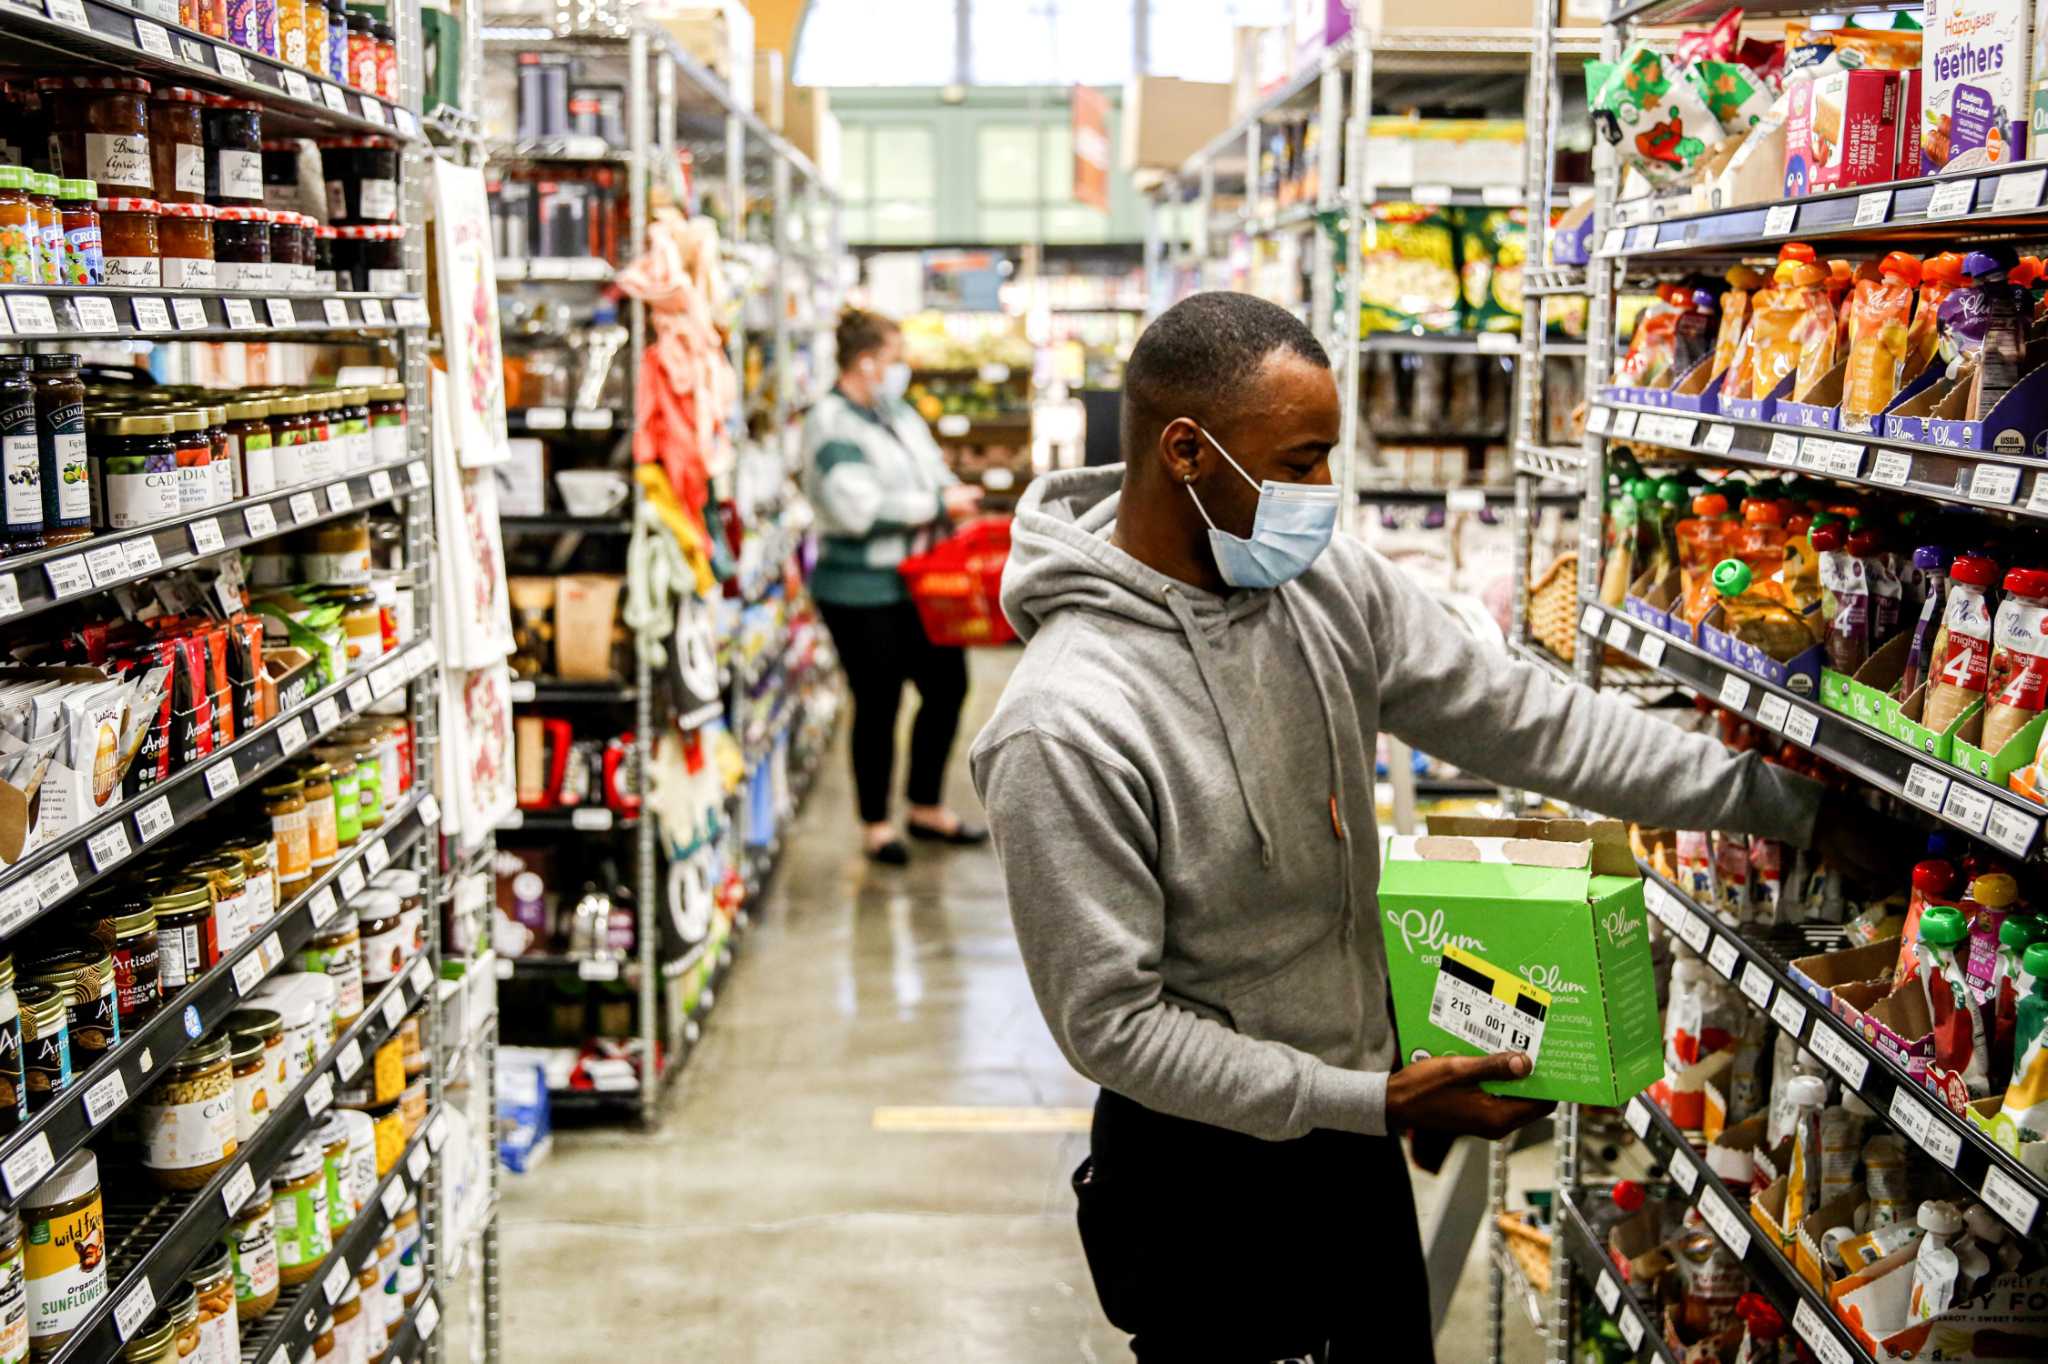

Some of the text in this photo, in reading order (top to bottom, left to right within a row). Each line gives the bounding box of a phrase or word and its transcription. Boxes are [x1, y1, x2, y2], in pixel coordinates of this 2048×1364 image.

[1934, 41, 2003, 82] teethers
[2000, 435, 2019, 445] USDA
[178, 468, 206, 481] DIA
[1834, 603, 1855, 638] 4
[1950, 635, 1984, 652] mighty
[1943, 648, 1972, 688] 4
[2003, 666, 2029, 707] 4
[1386, 908, 1488, 955] Plum
[1601, 905, 1641, 945] Plum
[1519, 964, 1588, 994] Plum
[1450, 996, 1472, 1016] 215
[1485, 1014, 1506, 1034] 001
[54, 1219, 83, 1247] wild
